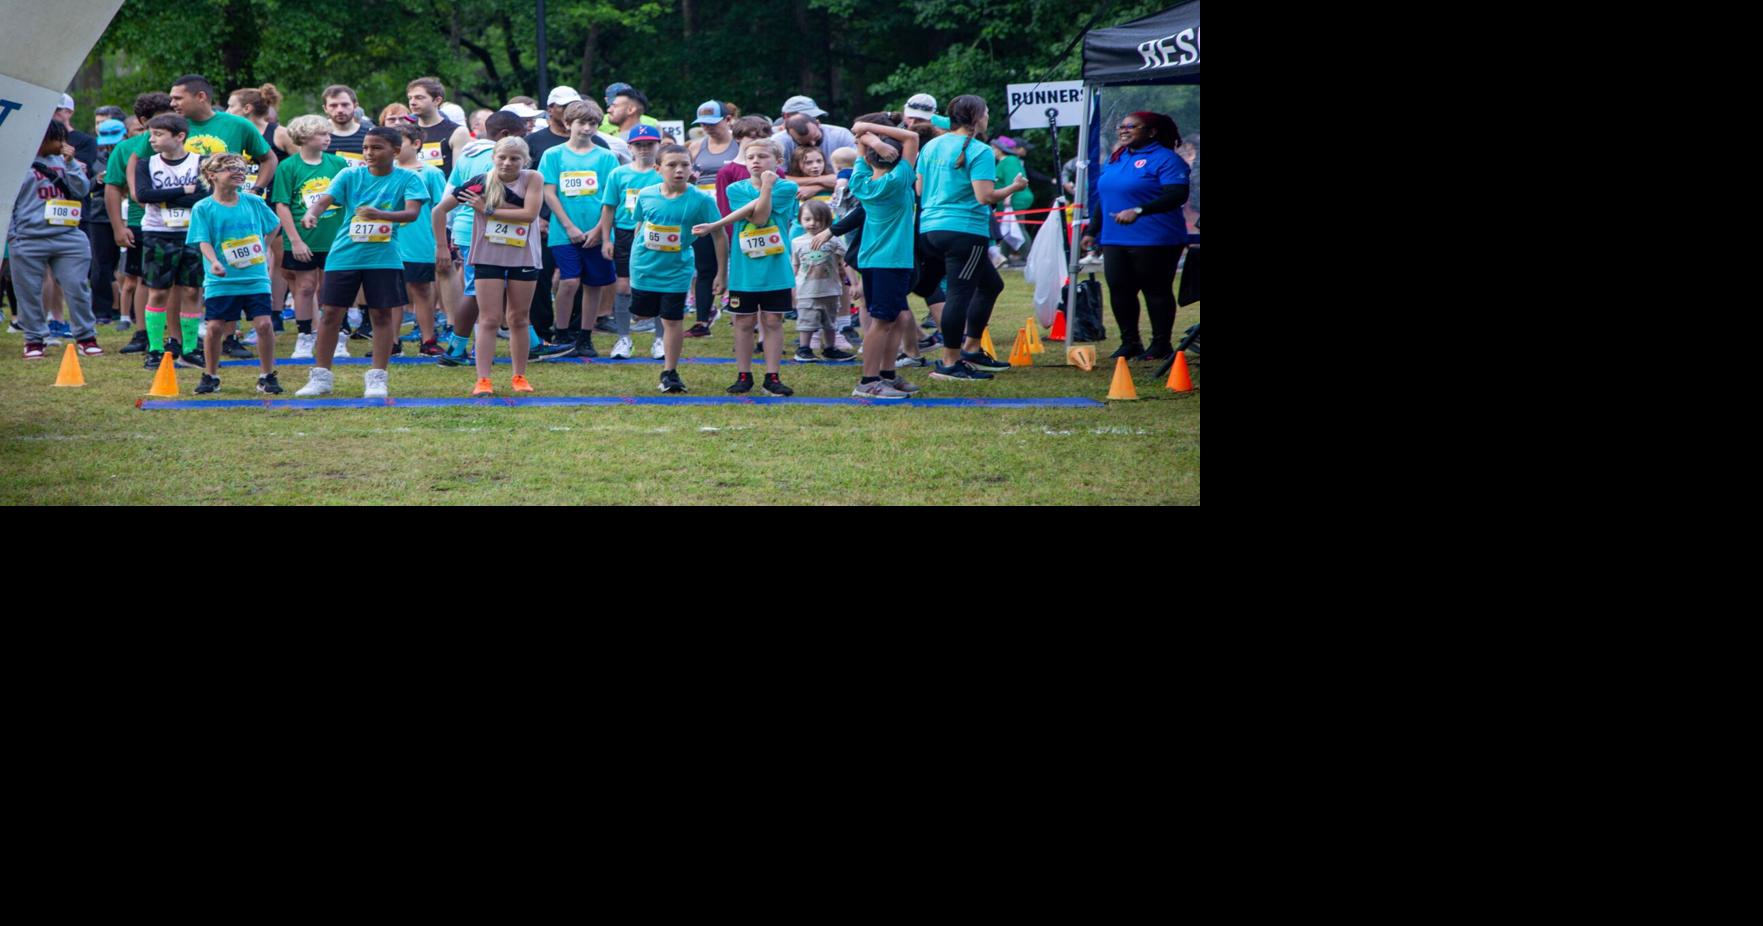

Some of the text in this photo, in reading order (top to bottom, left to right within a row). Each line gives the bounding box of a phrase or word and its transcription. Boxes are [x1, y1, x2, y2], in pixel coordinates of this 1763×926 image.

[1138, 27, 1200, 70] RES
[0, 99, 23, 127] T
[565, 178, 582, 188] 209
[53, 207, 68, 217] 108
[168, 208, 185, 217] 157
[355, 224, 374, 234] 217
[495, 223, 508, 234] 24
[649, 231, 660, 242] 65
[747, 237, 766, 249] 178
[232, 247, 250, 259] 169
